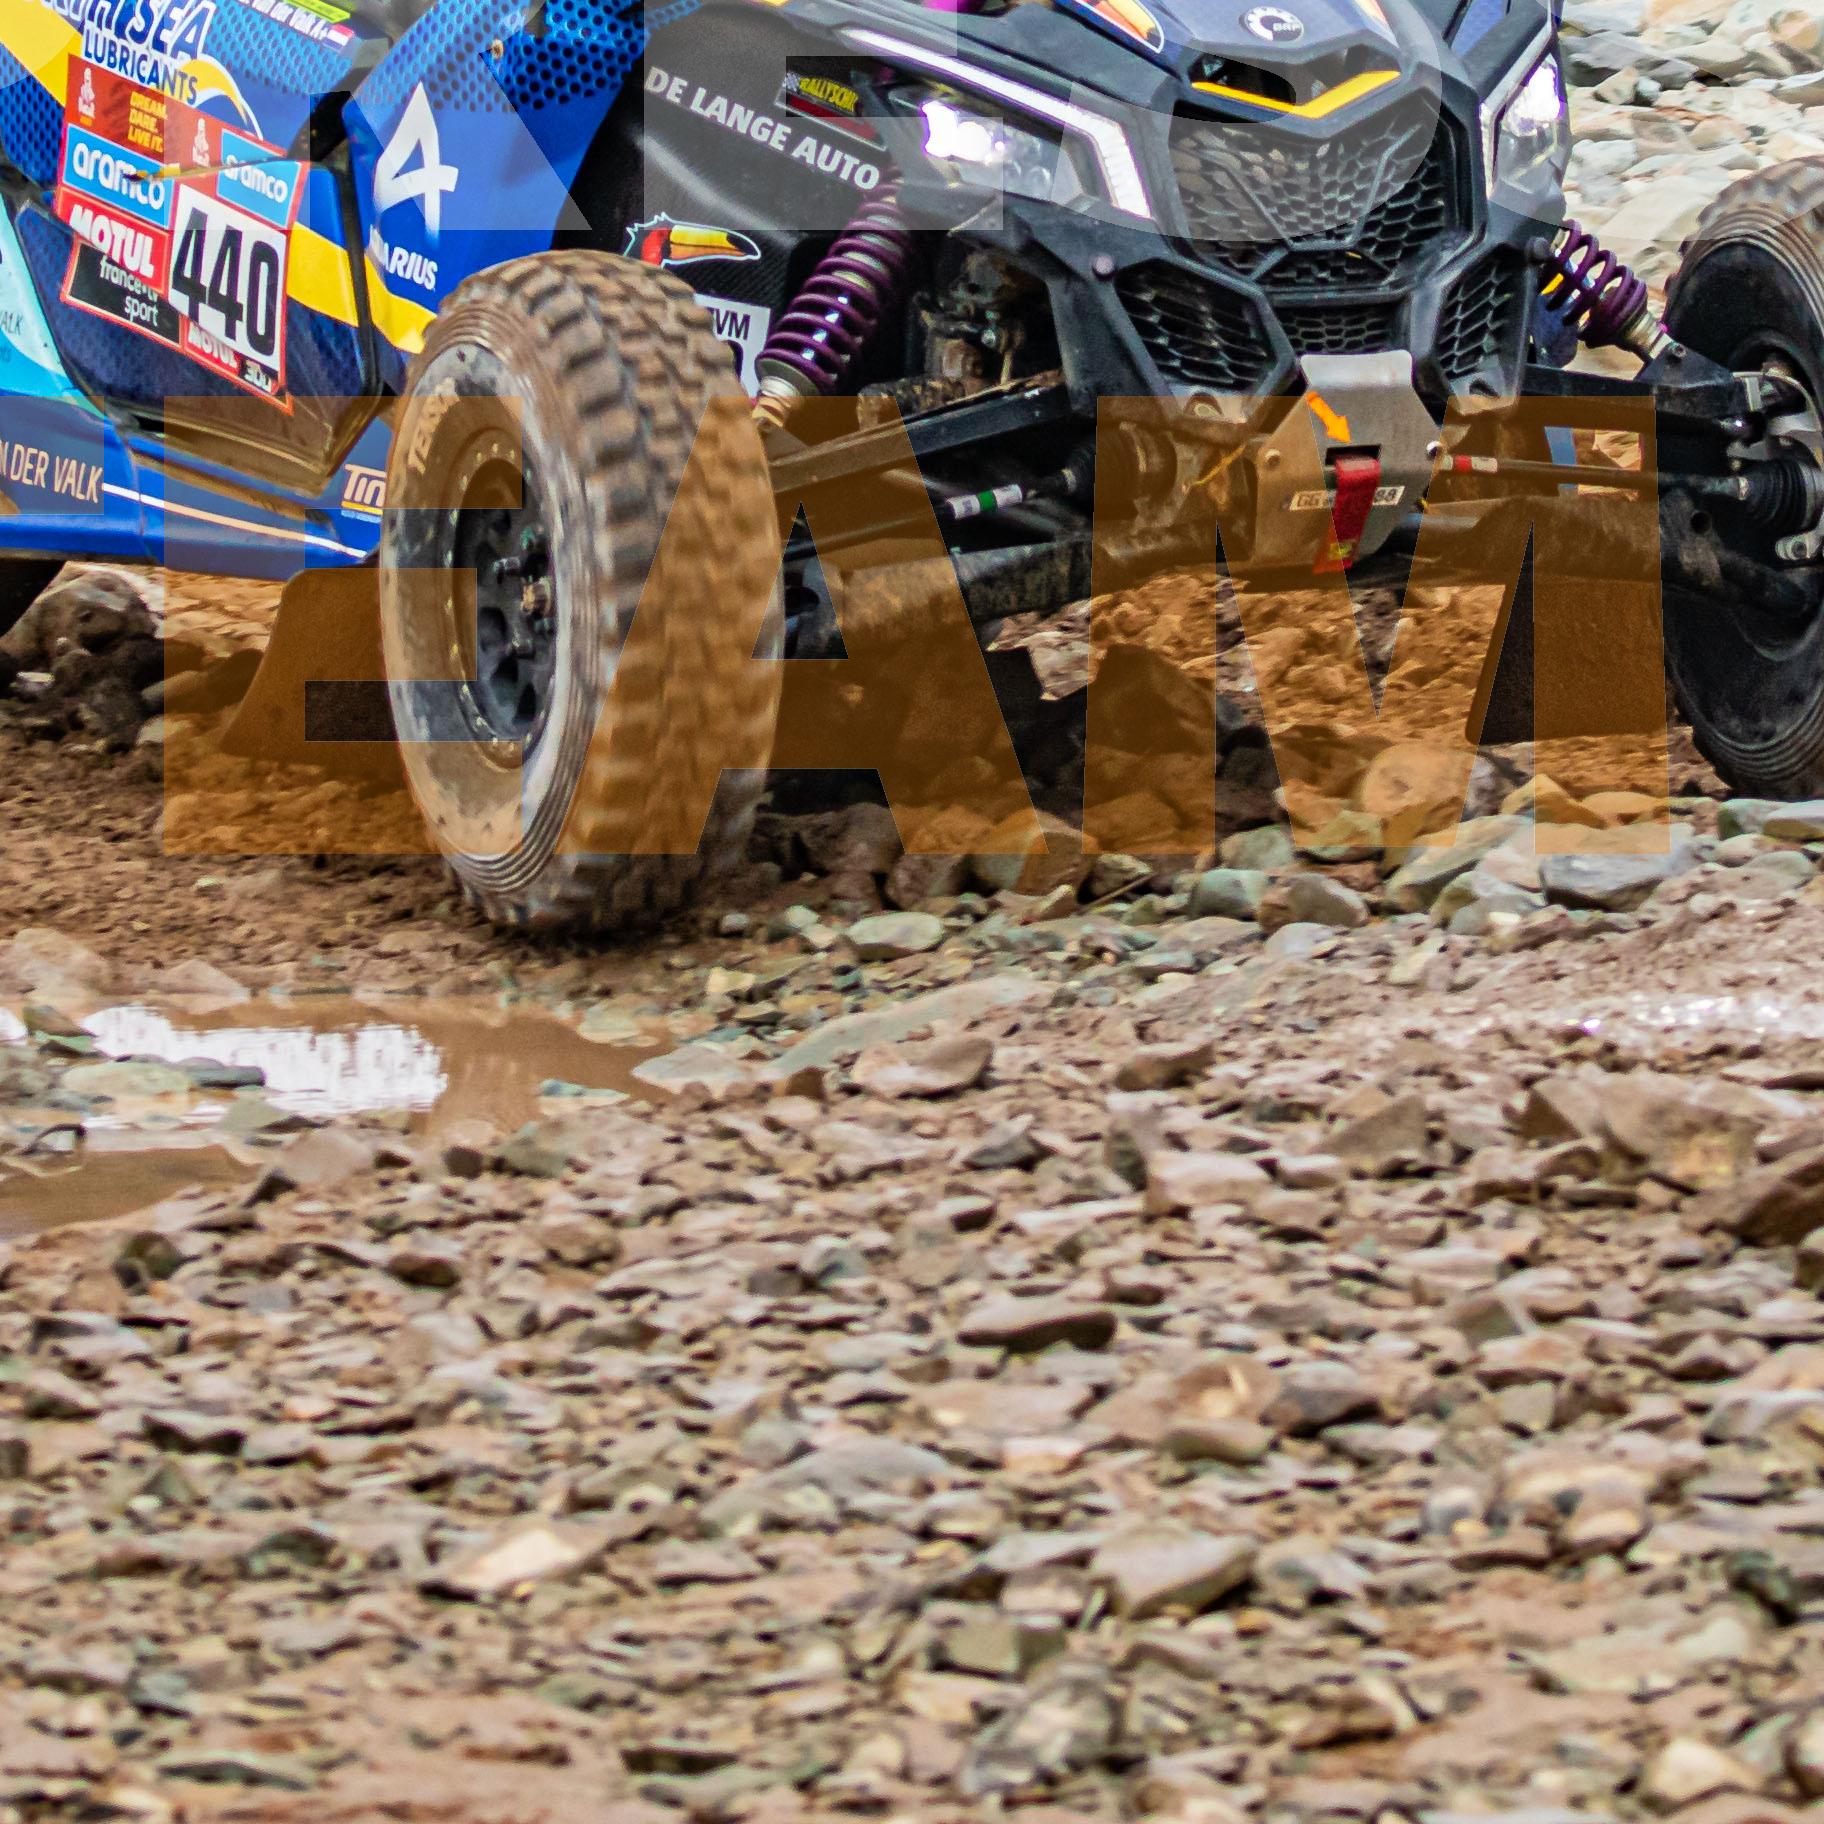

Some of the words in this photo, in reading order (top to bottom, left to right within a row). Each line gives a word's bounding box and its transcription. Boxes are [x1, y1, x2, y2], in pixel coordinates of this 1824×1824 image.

[83, 20, 199, 105] LUBRICANTS
[644, 66, 688, 104] DE
[689, 86, 792, 152] LANGE
[790, 136, 880, 190] AUTO
[72, 142, 166, 211] aramco
[68, 204, 156, 279] MOTUL
[124, 294, 160, 327] sport
[172, 206, 281, 358] 440
[708, 306, 752, 341] VM
[9, 443, 50, 489] DER
[53, 455, 104, 504] VALK
